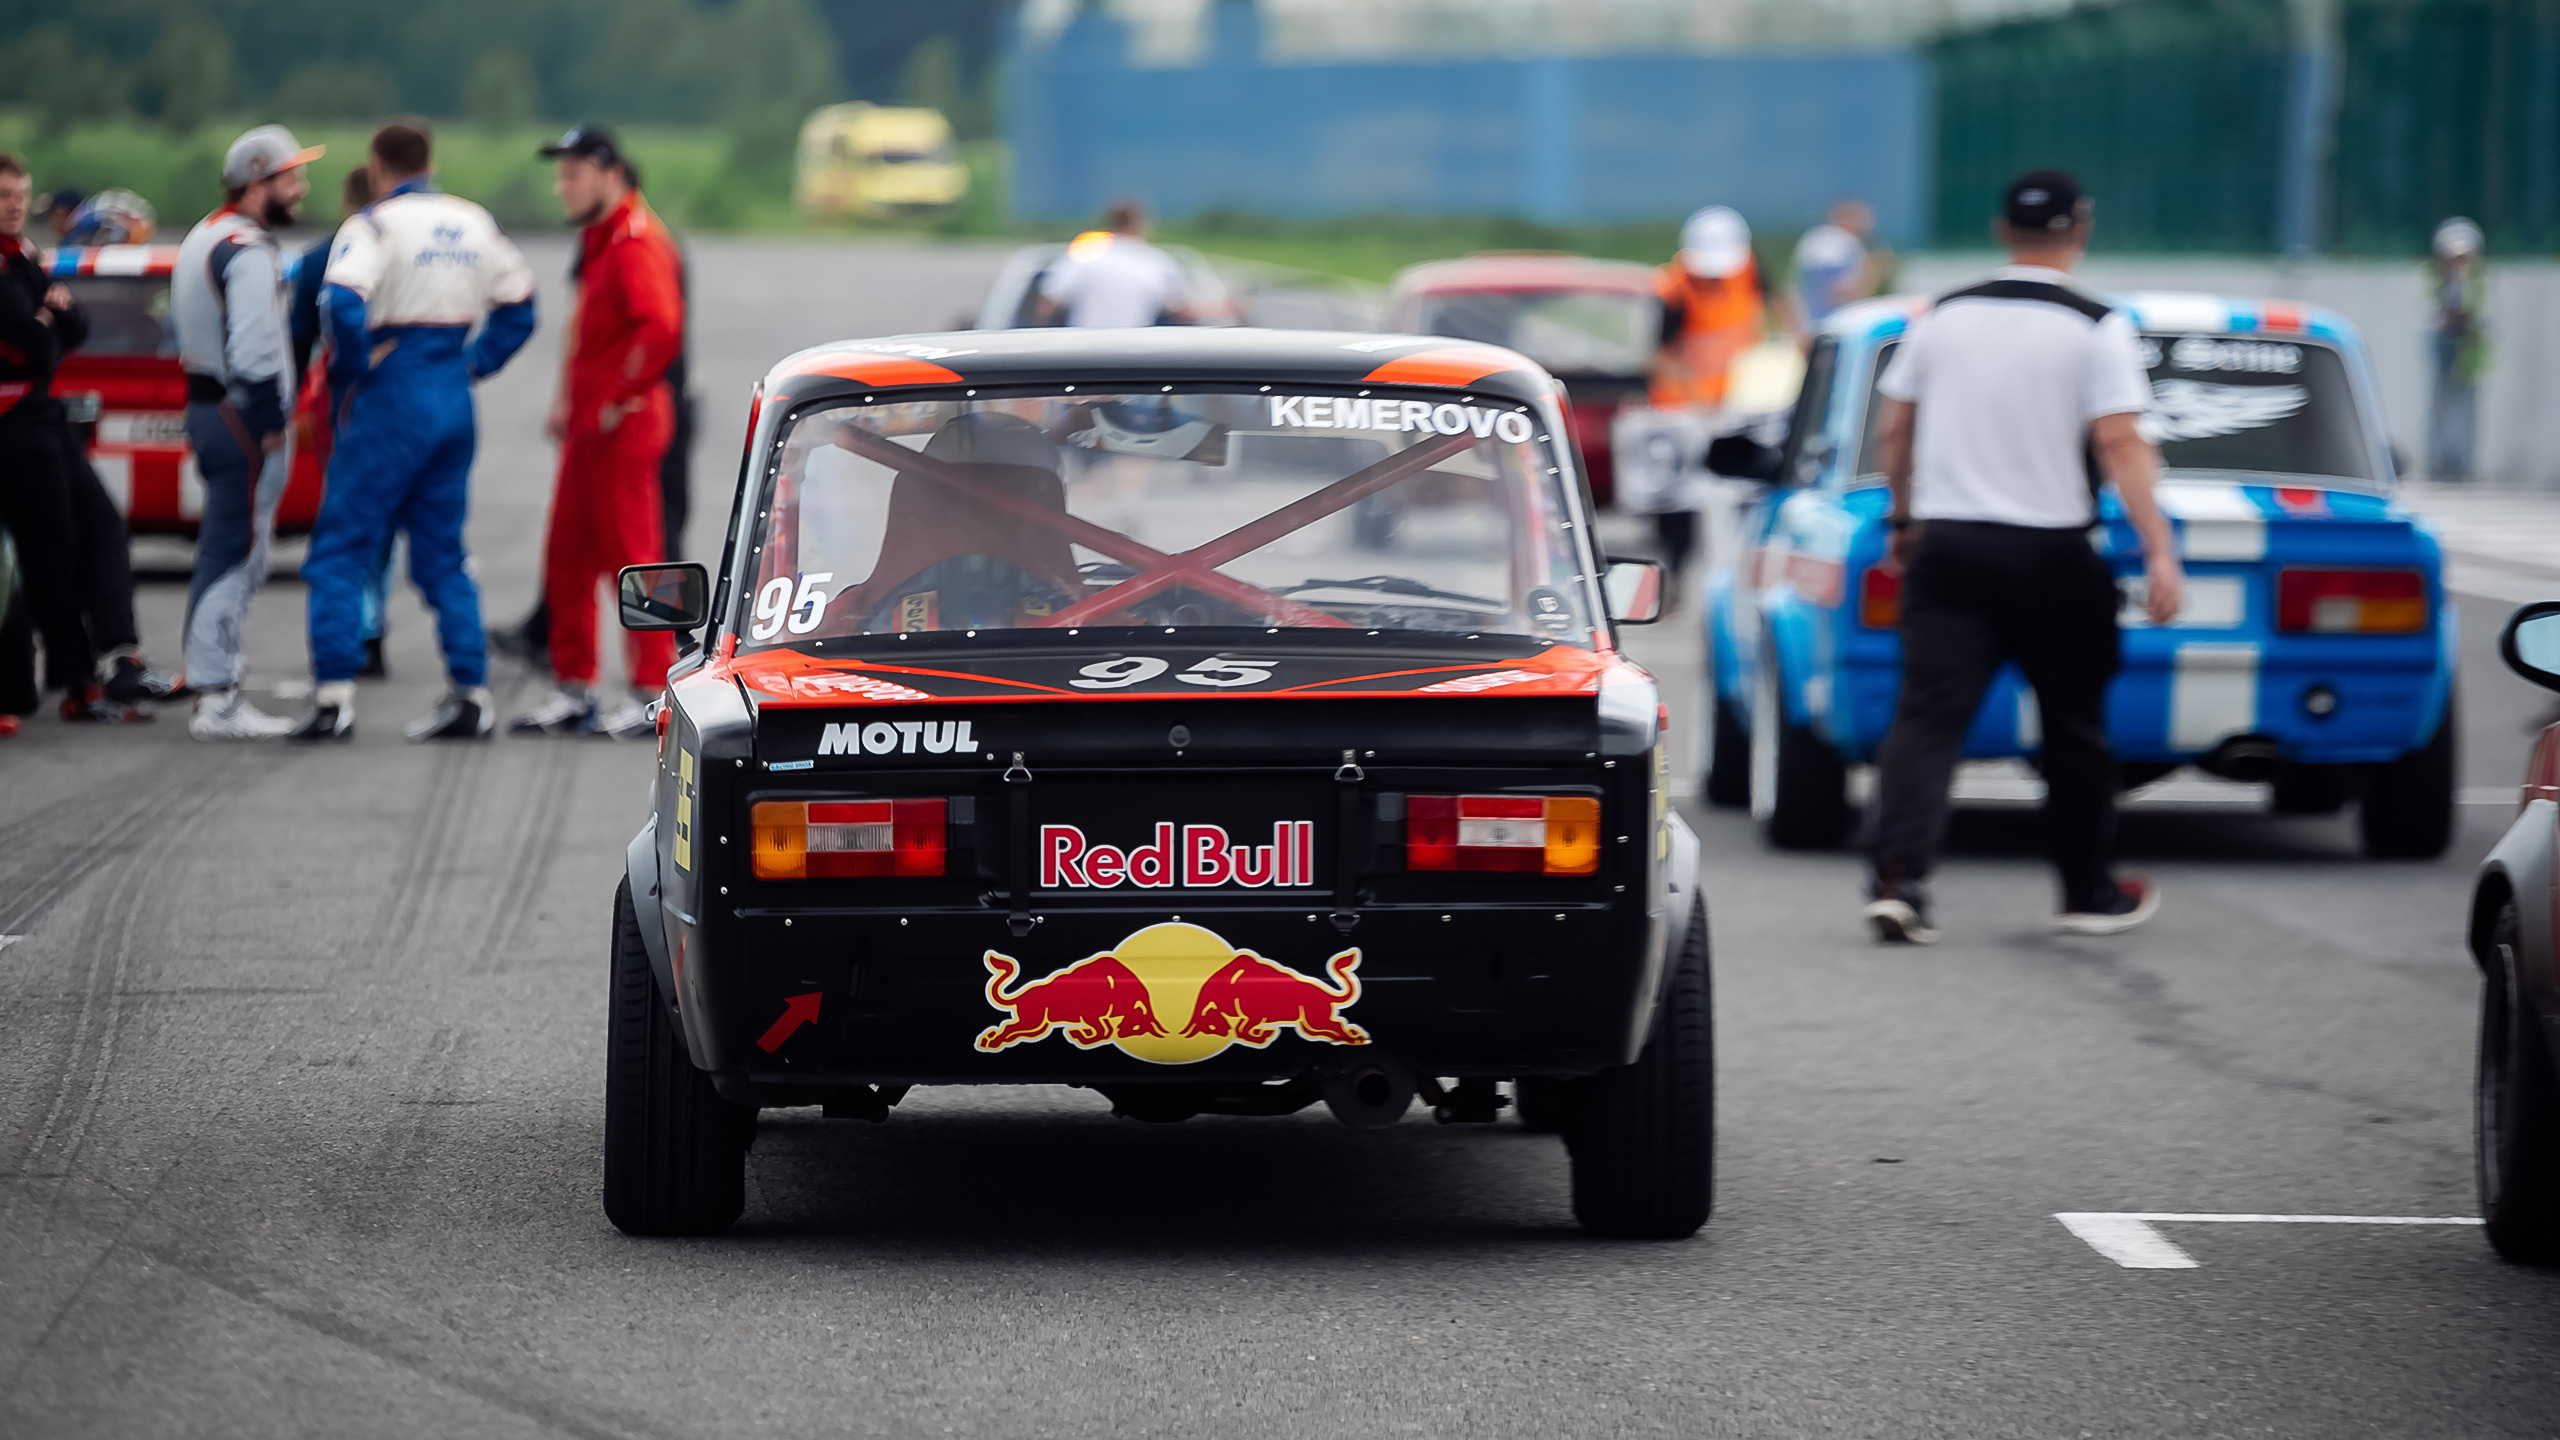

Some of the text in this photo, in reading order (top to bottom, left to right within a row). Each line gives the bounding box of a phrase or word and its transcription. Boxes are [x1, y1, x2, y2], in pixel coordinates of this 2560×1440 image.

[1269, 395, 1534, 444] KEMEROVO
[751, 571, 834, 641] 95
[1068, 655, 1280, 690] 95
[817, 720, 979, 756] MOTUL
[1040, 820, 1314, 889] Red Bull
